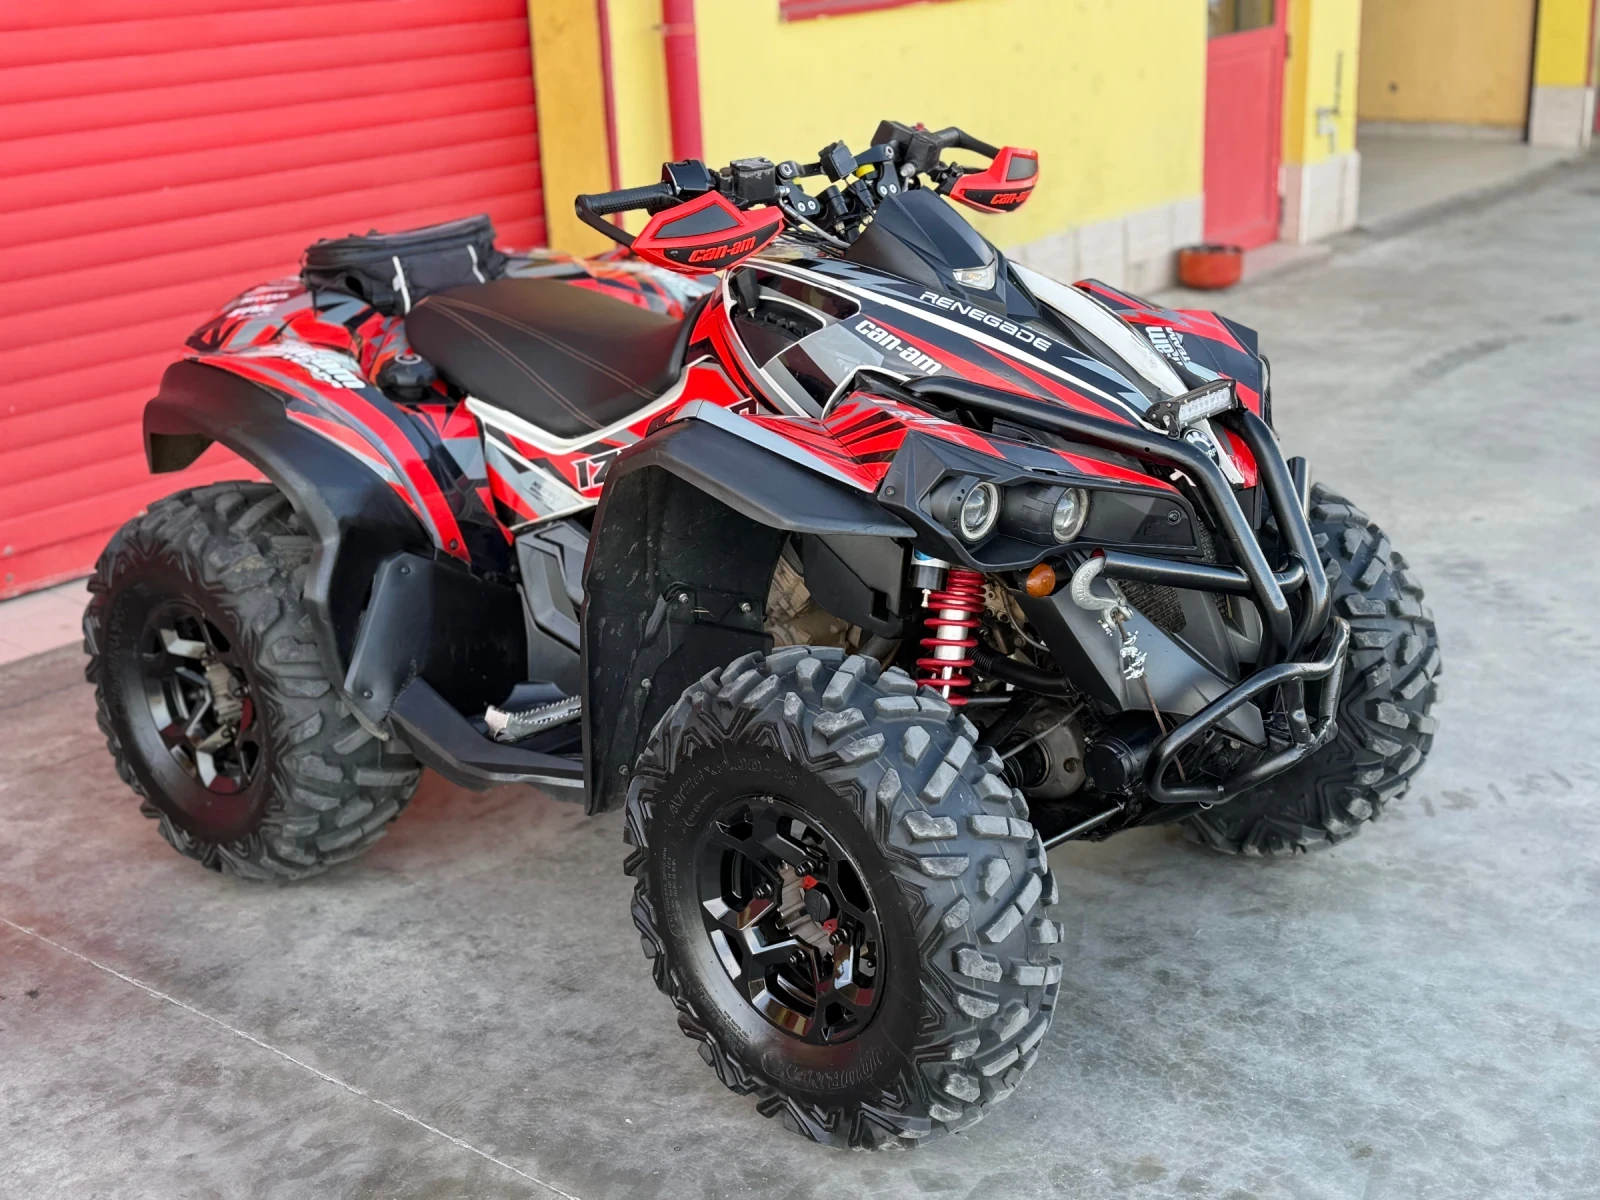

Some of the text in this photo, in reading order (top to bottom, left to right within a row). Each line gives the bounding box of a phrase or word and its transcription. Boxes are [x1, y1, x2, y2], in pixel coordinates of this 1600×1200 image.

[688, 236, 757, 263] can-am
[854, 319, 943, 376] can-am
[1204, 447, 1217, 458] RP
